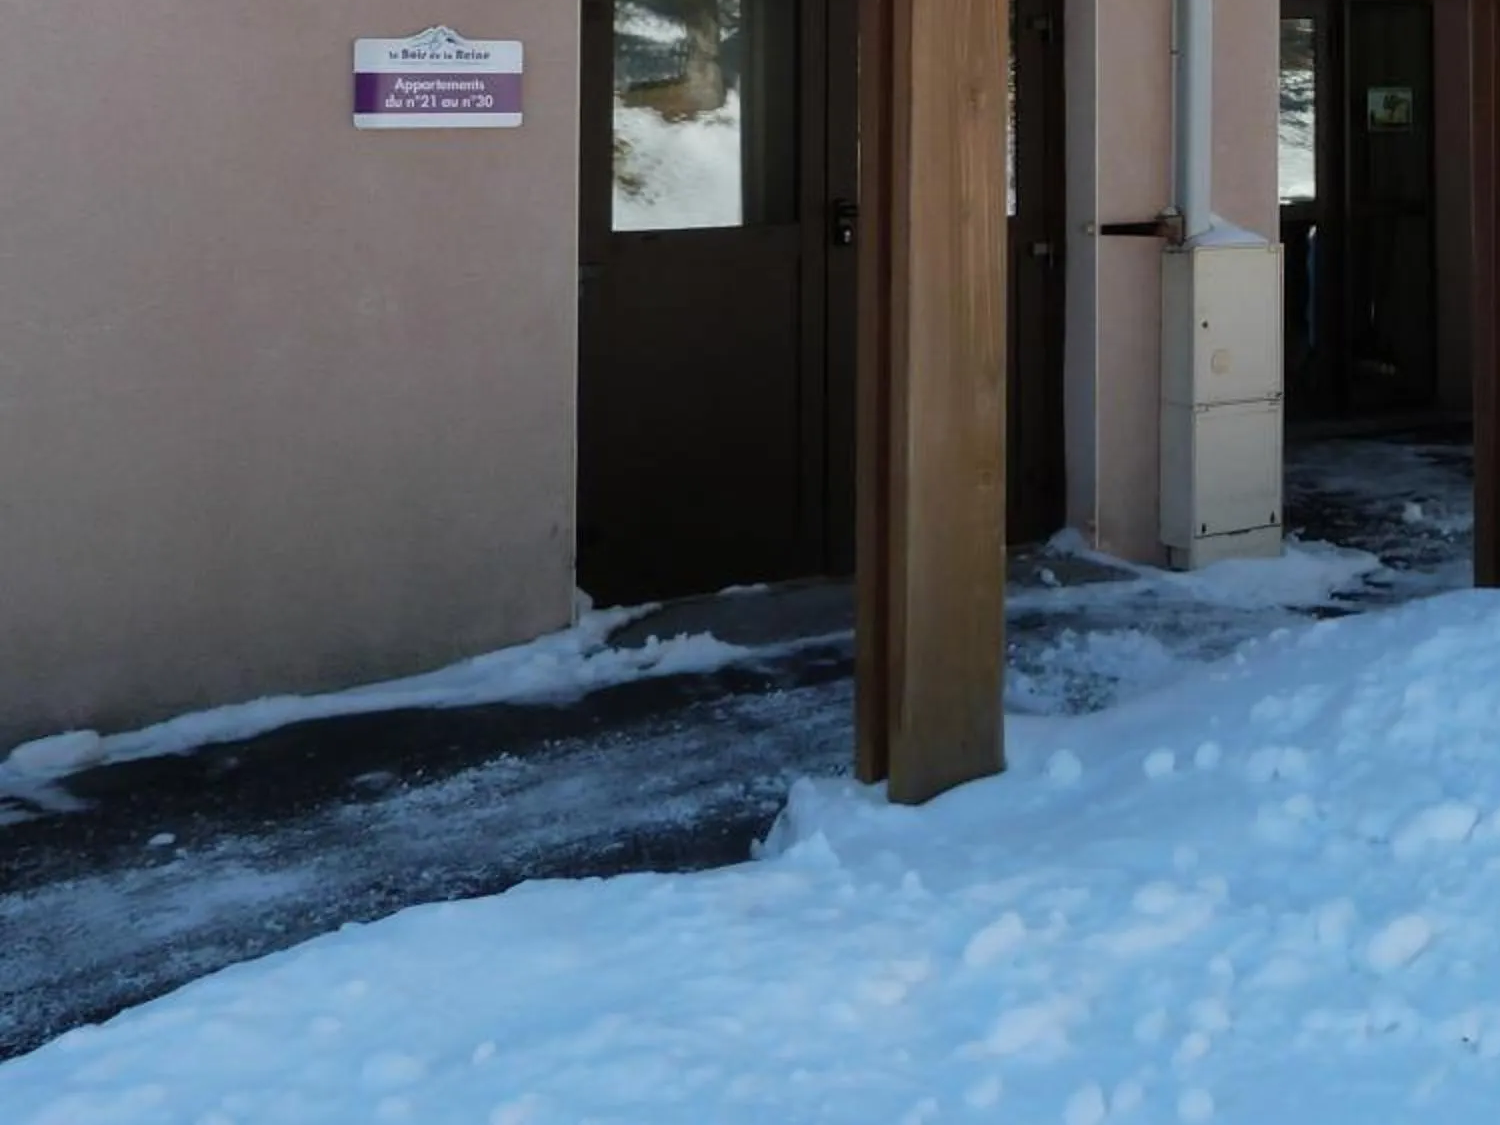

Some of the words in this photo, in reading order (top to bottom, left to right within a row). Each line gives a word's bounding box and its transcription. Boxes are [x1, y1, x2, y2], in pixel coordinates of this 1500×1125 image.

[394, 77, 485, 93] Appartements
[385, 94, 403, 108] du
[441, 98, 459, 108] au
